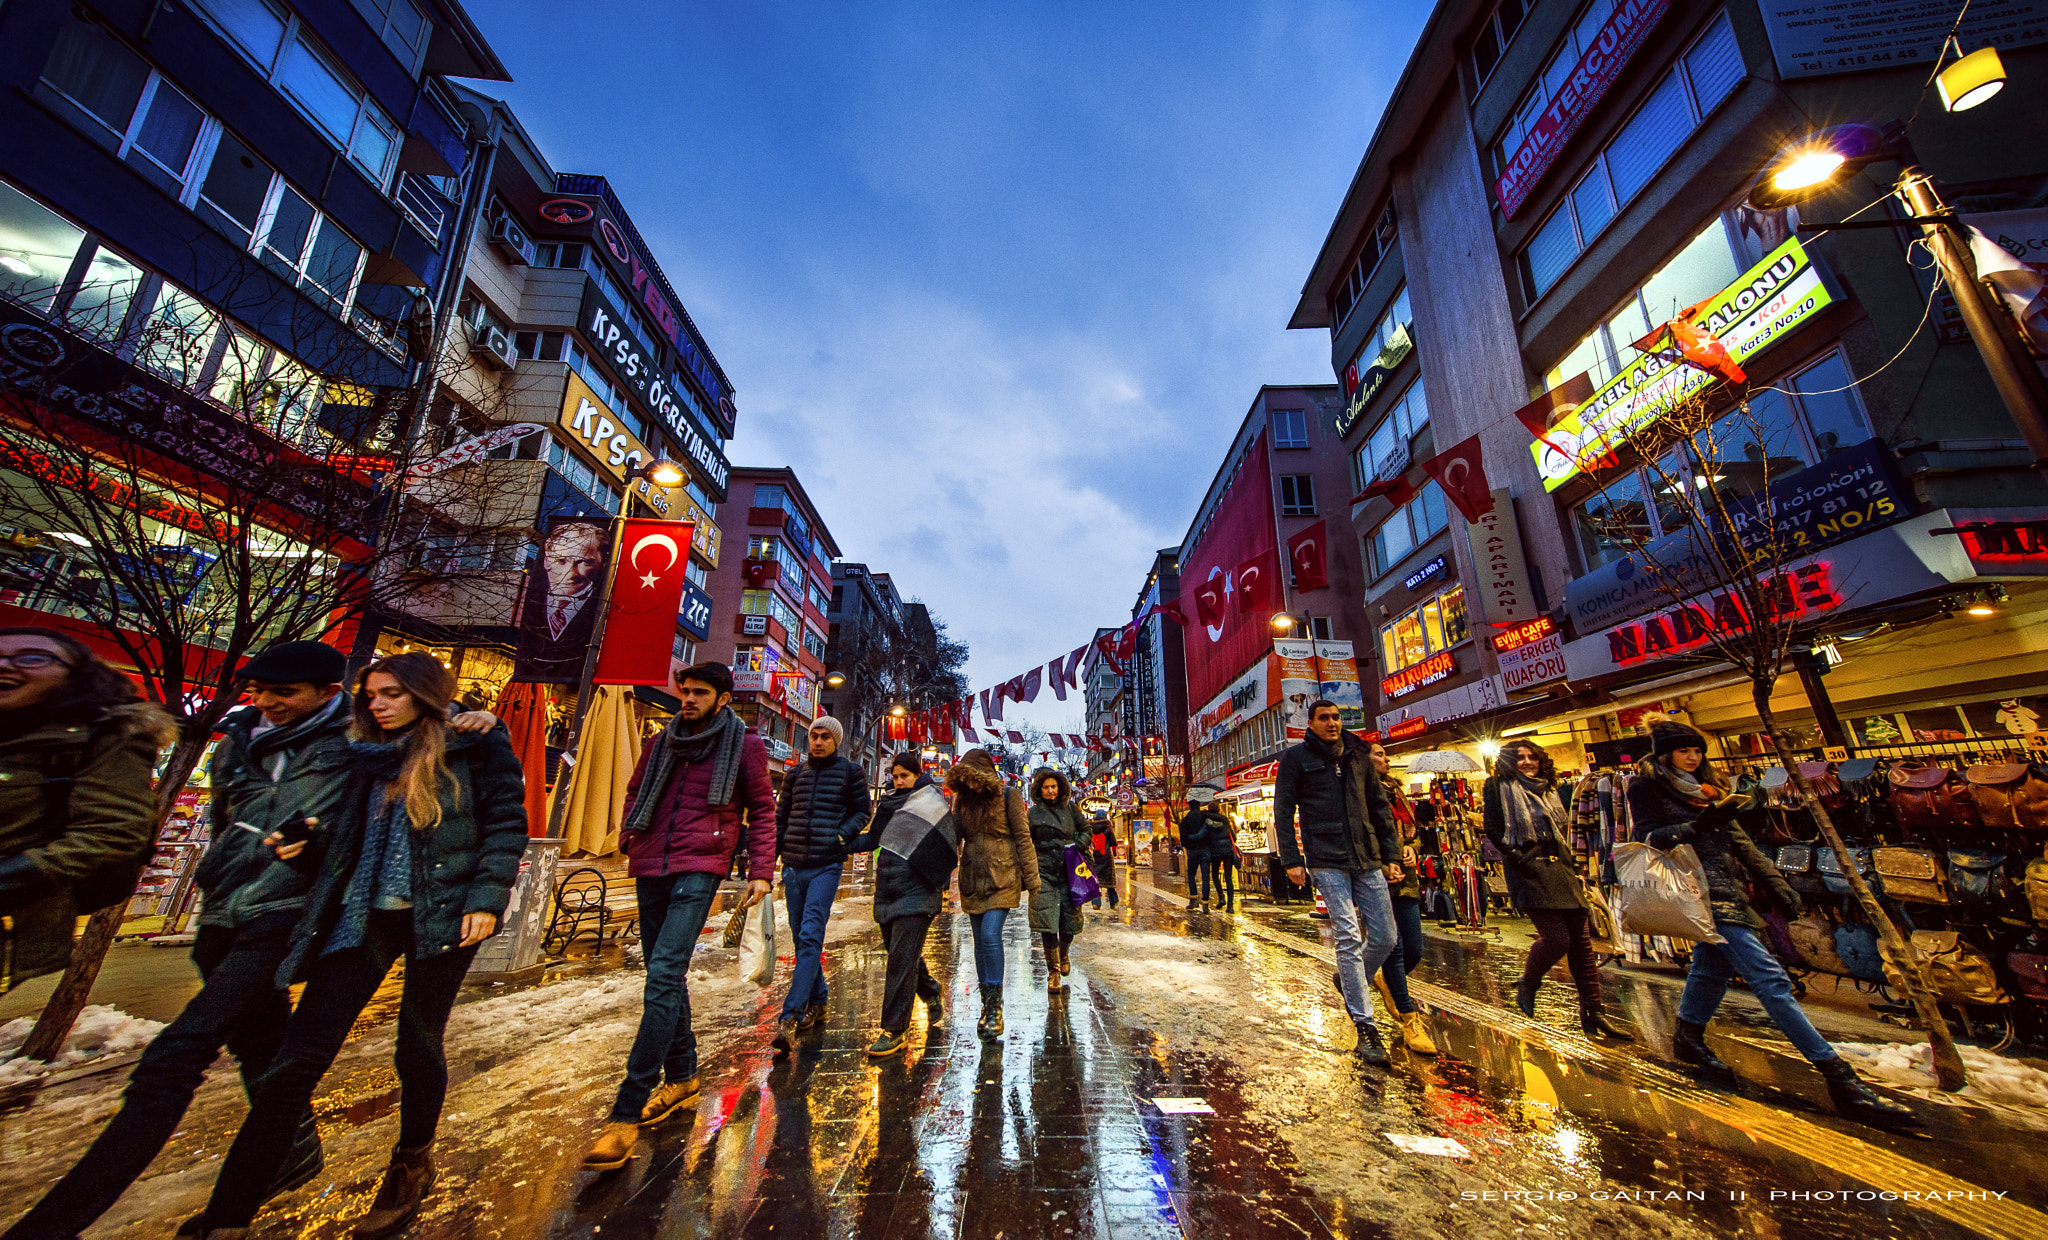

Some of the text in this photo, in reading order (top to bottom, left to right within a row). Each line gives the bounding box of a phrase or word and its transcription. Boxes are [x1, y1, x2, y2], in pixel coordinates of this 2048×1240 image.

[1800, 61, 1822, 71] Tel
[1837, 56, 1866, 66] 418
[1872, 53, 1892, 62] 44
[1897, 49, 1917, 58] 48
[1981, 35, 2014, 46] 418
[2022, 29, 2045, 39] 44
[1501, 126, 1550, 199] AKDİL
[1740, 328, 1772, 355] Kat:3
[1773, 296, 1815, 334] No:10
[1757, 294, 1788, 323] Kol
[590, 307, 640, 377] KPSS
[649, 374, 728, 491] ÖĞRETMENLİK
[1776, 509, 1813, 535] 417
[1821, 495, 1847, 514] 81
[1855, 479, 1888, 498] 12
[1783, 463, 1875, 512] FOTOKOPİ
[1793, 530, 1811, 548] 2
[1816, 496, 1896, 539] NO/5
[1438, 557, 1444, 567] 3
[1577, 581, 1633, 618] KONICA
[1495, 618, 1551, 648] EVİM CAFE
[1501, 637, 1561, 665] CLASS ERKEK
[1502, 653, 1567, 689] KUAFÖRÜ
